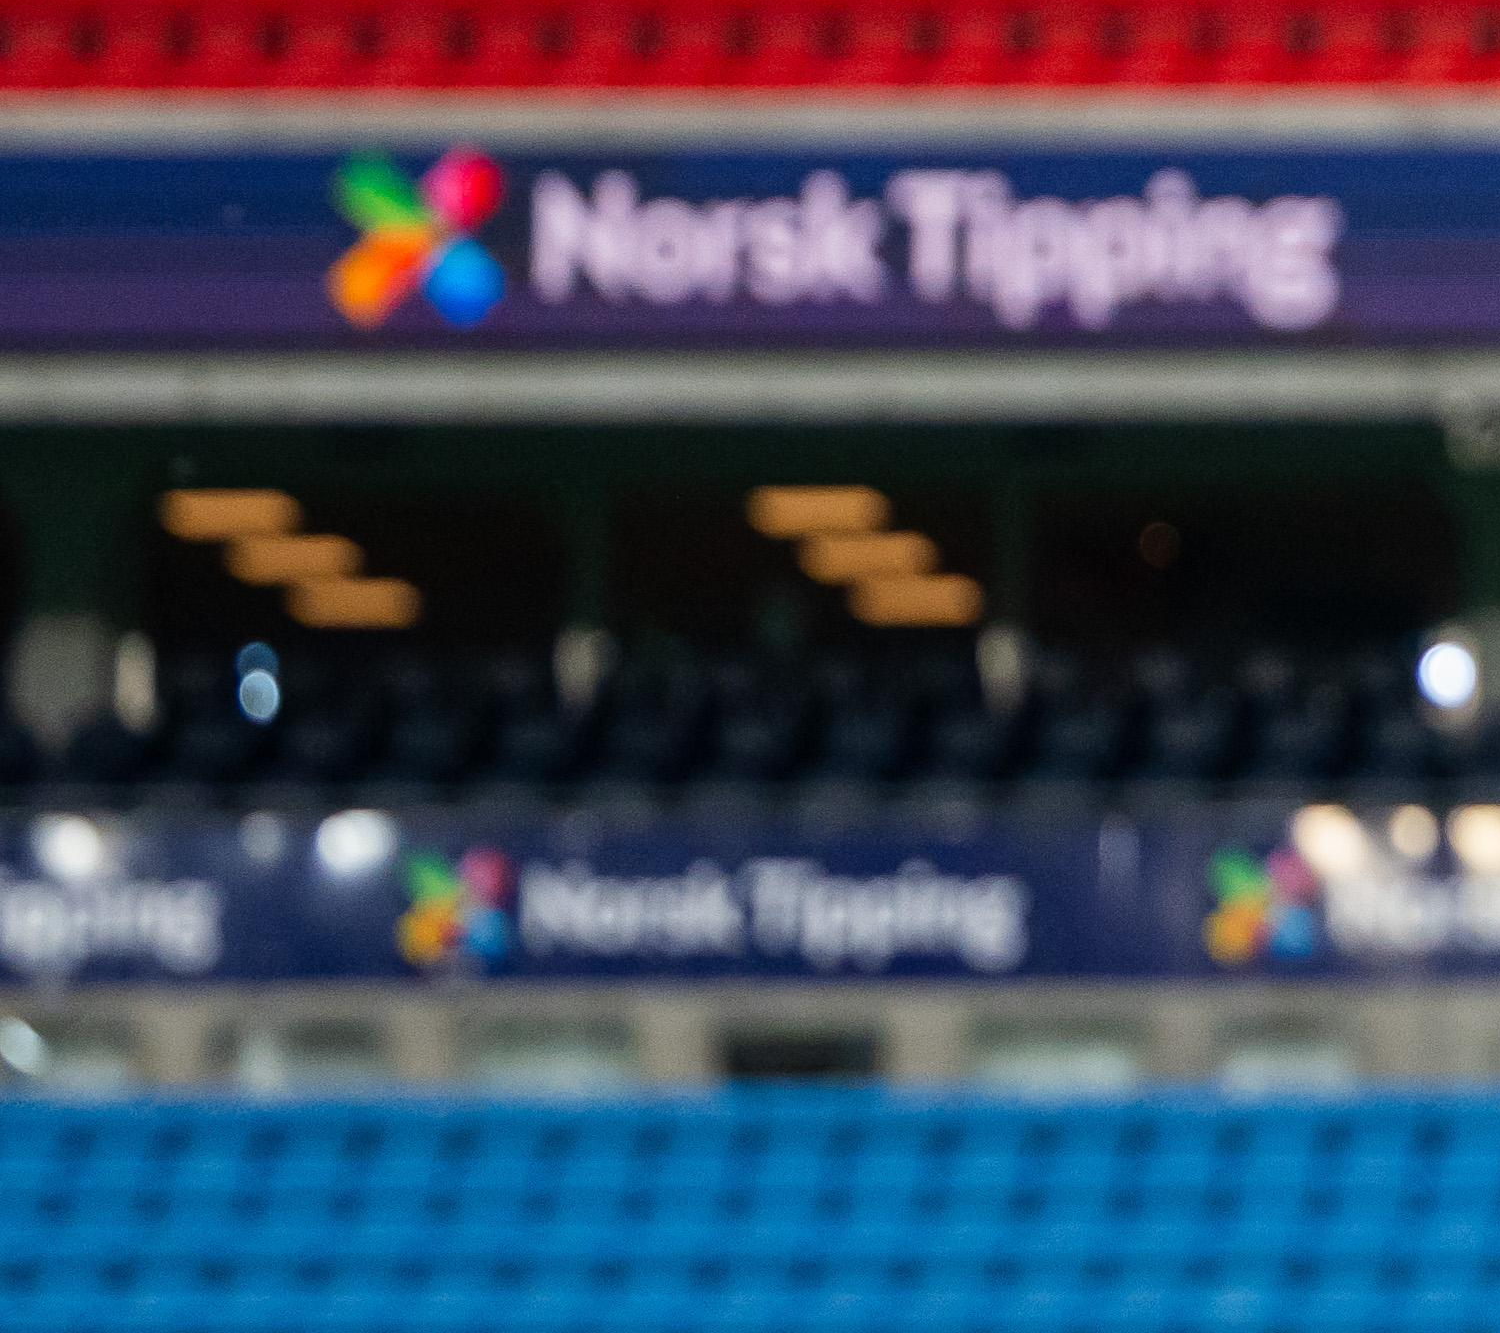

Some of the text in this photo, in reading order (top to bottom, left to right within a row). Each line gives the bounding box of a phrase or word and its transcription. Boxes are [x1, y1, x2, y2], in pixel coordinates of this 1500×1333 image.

[531, 168, 1344, 331] Norsk Tipping
[520, 858, 1028, 970] Norsk Tipping
